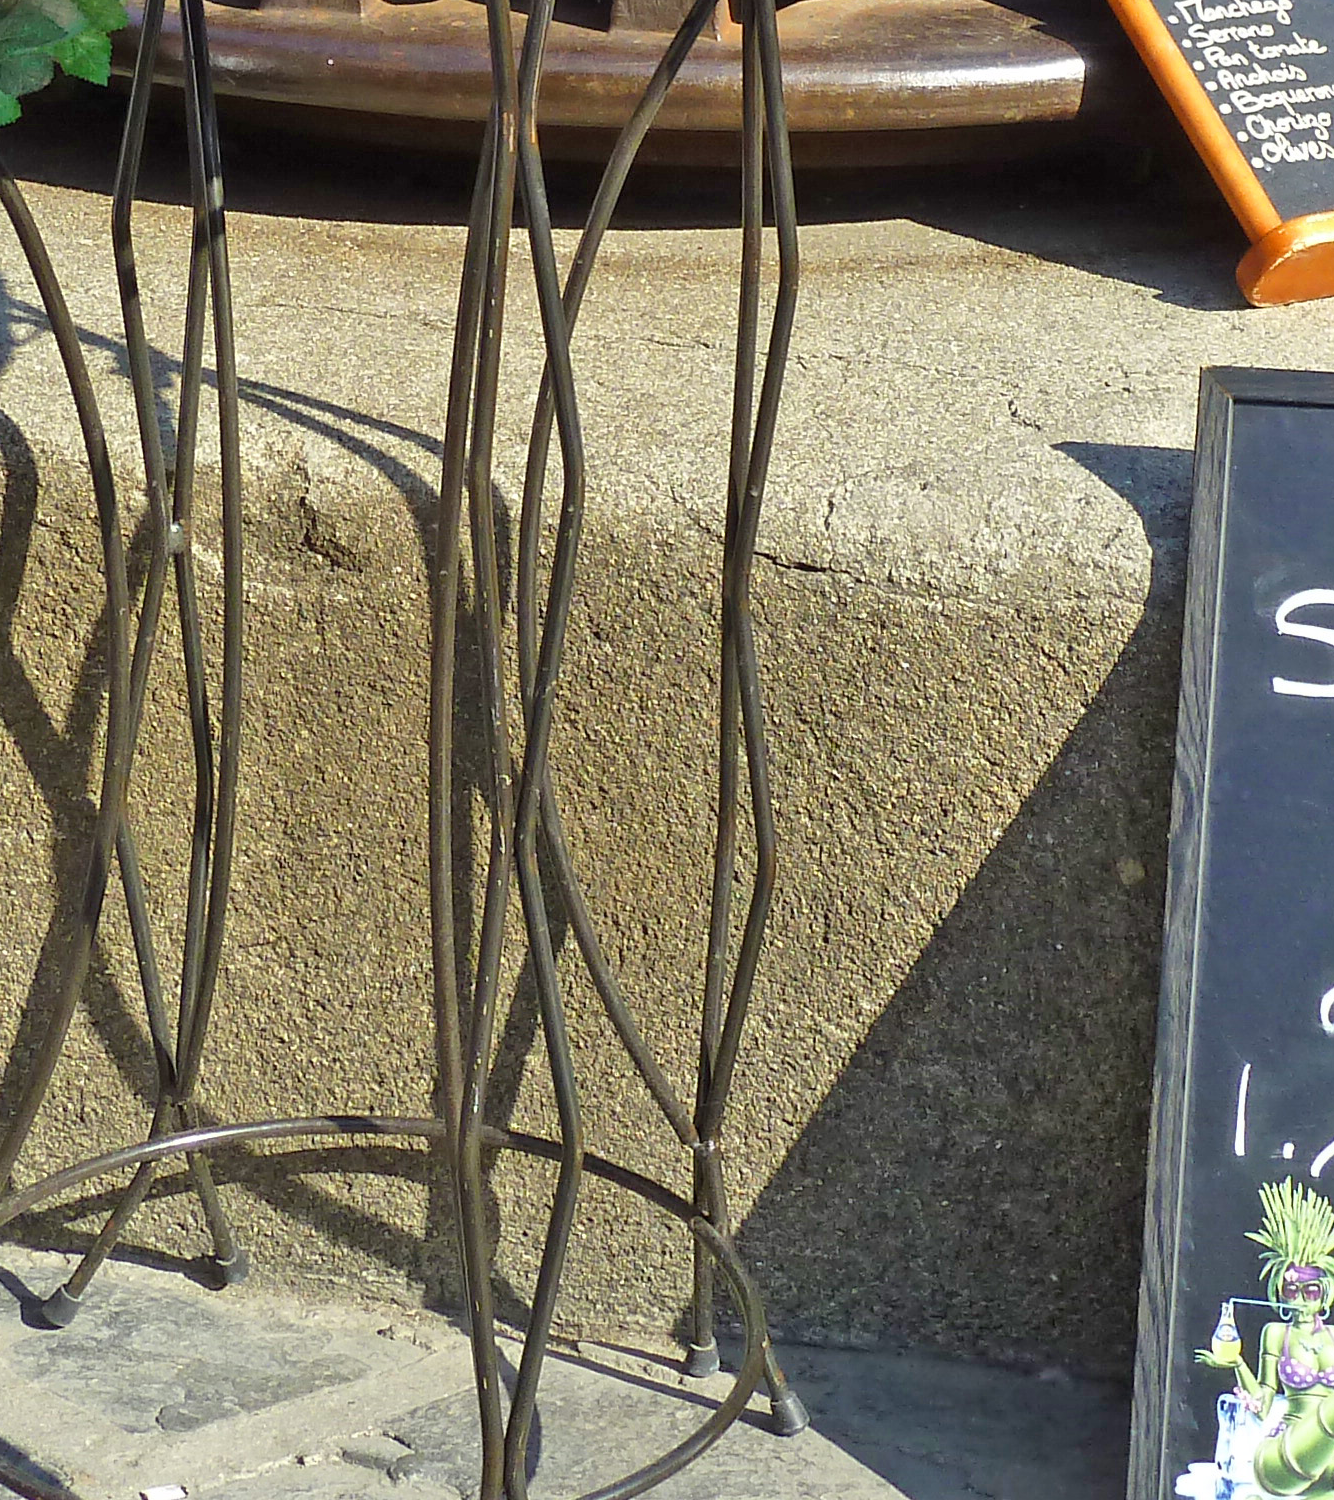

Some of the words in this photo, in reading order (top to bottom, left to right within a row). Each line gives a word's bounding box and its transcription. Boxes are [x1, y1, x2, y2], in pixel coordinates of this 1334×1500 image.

[1188, 23, 1275, 49] Serrano
[1203, 46, 1249, 68] Pan
[1217, 62, 1308, 91] Anchois
[1245, 112, 1332, 141] Chorizo
